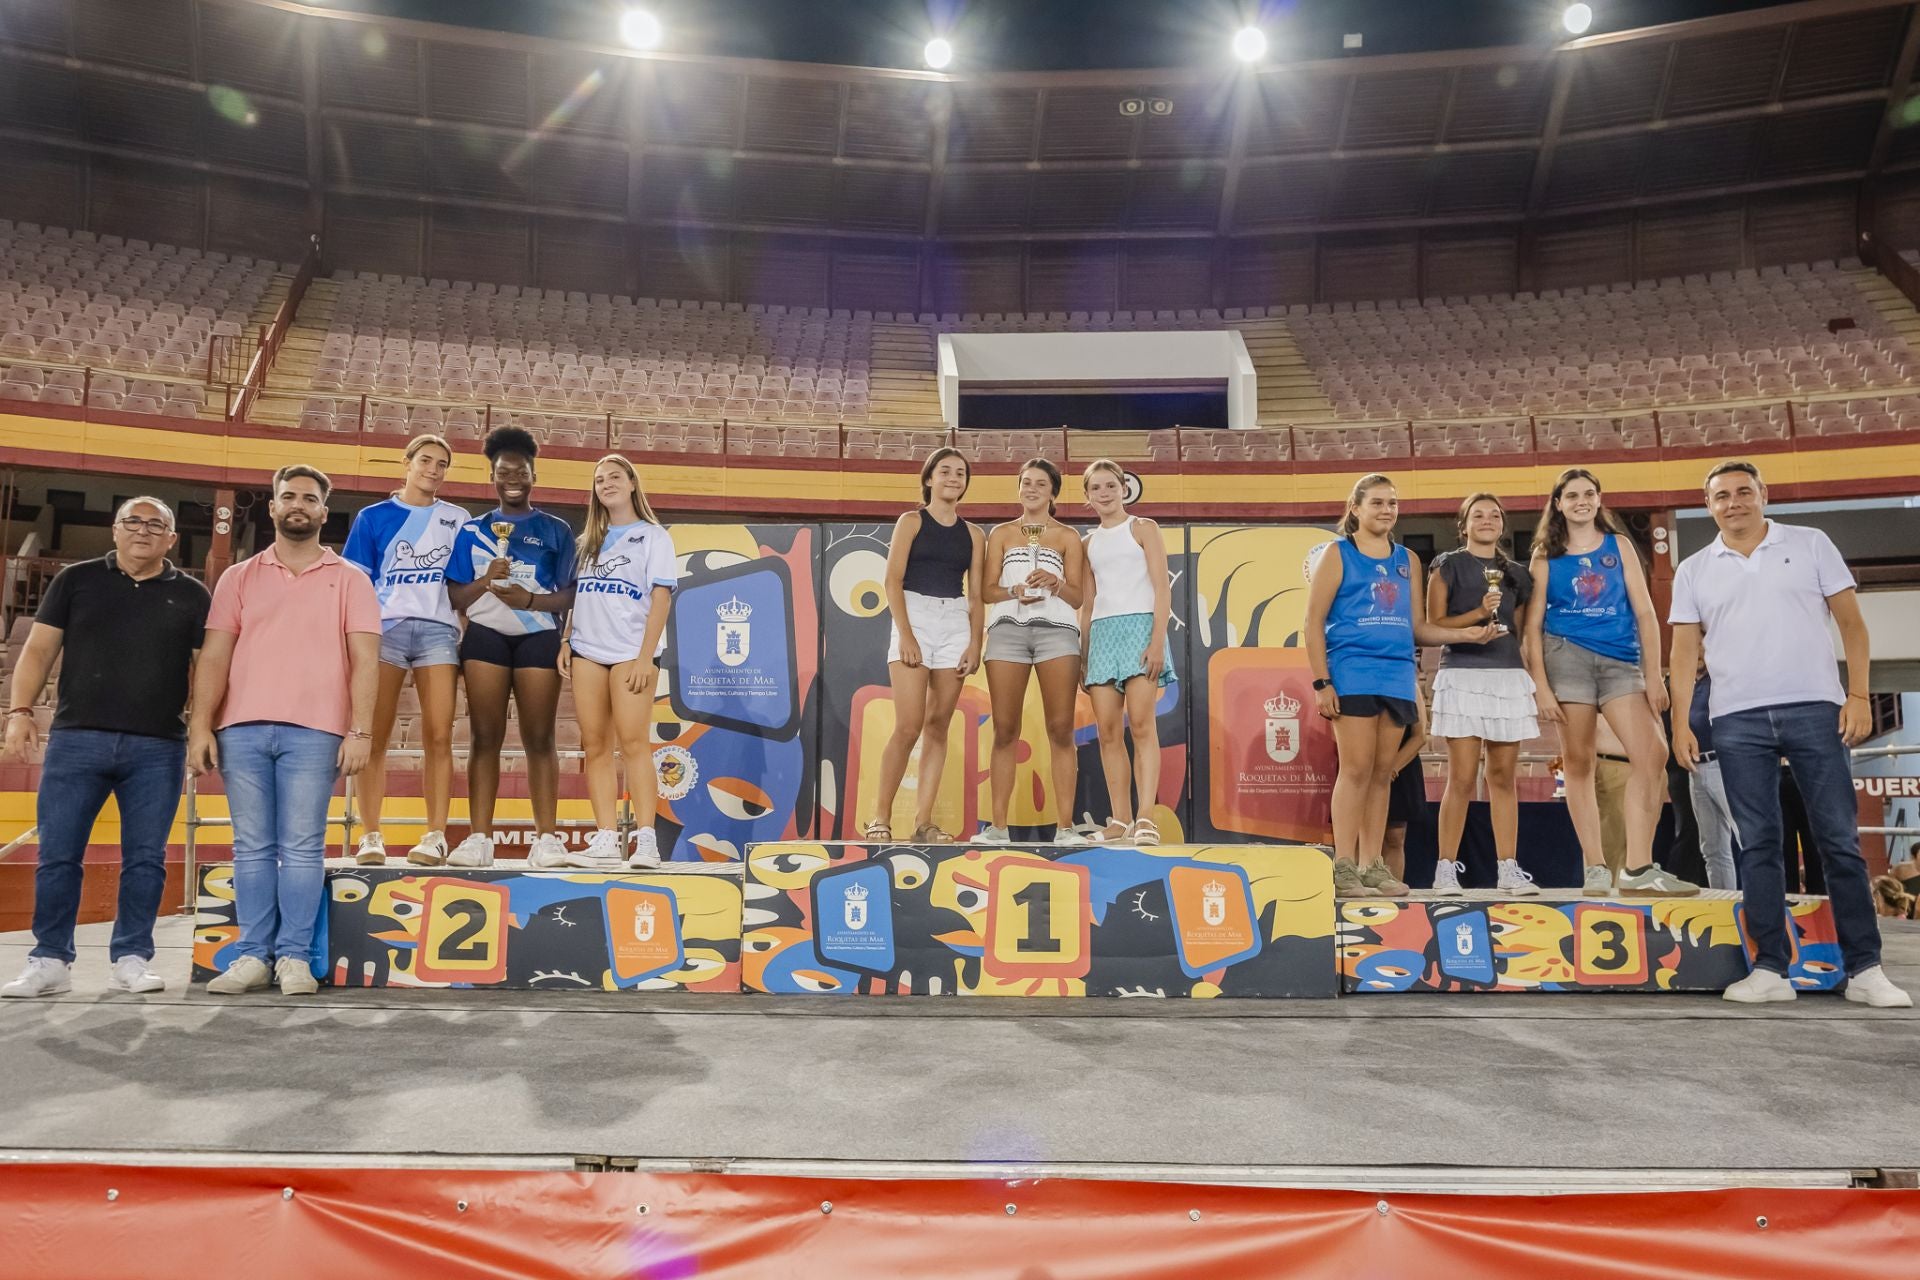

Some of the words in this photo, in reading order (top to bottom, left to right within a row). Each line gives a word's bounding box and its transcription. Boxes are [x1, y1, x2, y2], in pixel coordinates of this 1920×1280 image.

[386, 572, 447, 587] MICHE
[578, 582, 643, 601] ICHELIN
[690, 675, 736, 685] ROQUETAS
[753, 675, 775, 685] MAR
[1239, 772, 1287, 783] ROQUETAS
[1290, 774, 1300, 782] DE
[1305, 772, 1327, 782] MAR
[1852, 778, 1920, 796] PUER
[1012, 882, 1060, 952] 1
[438, 898, 489, 960] 2
[1590, 920, 1629, 970] 3
